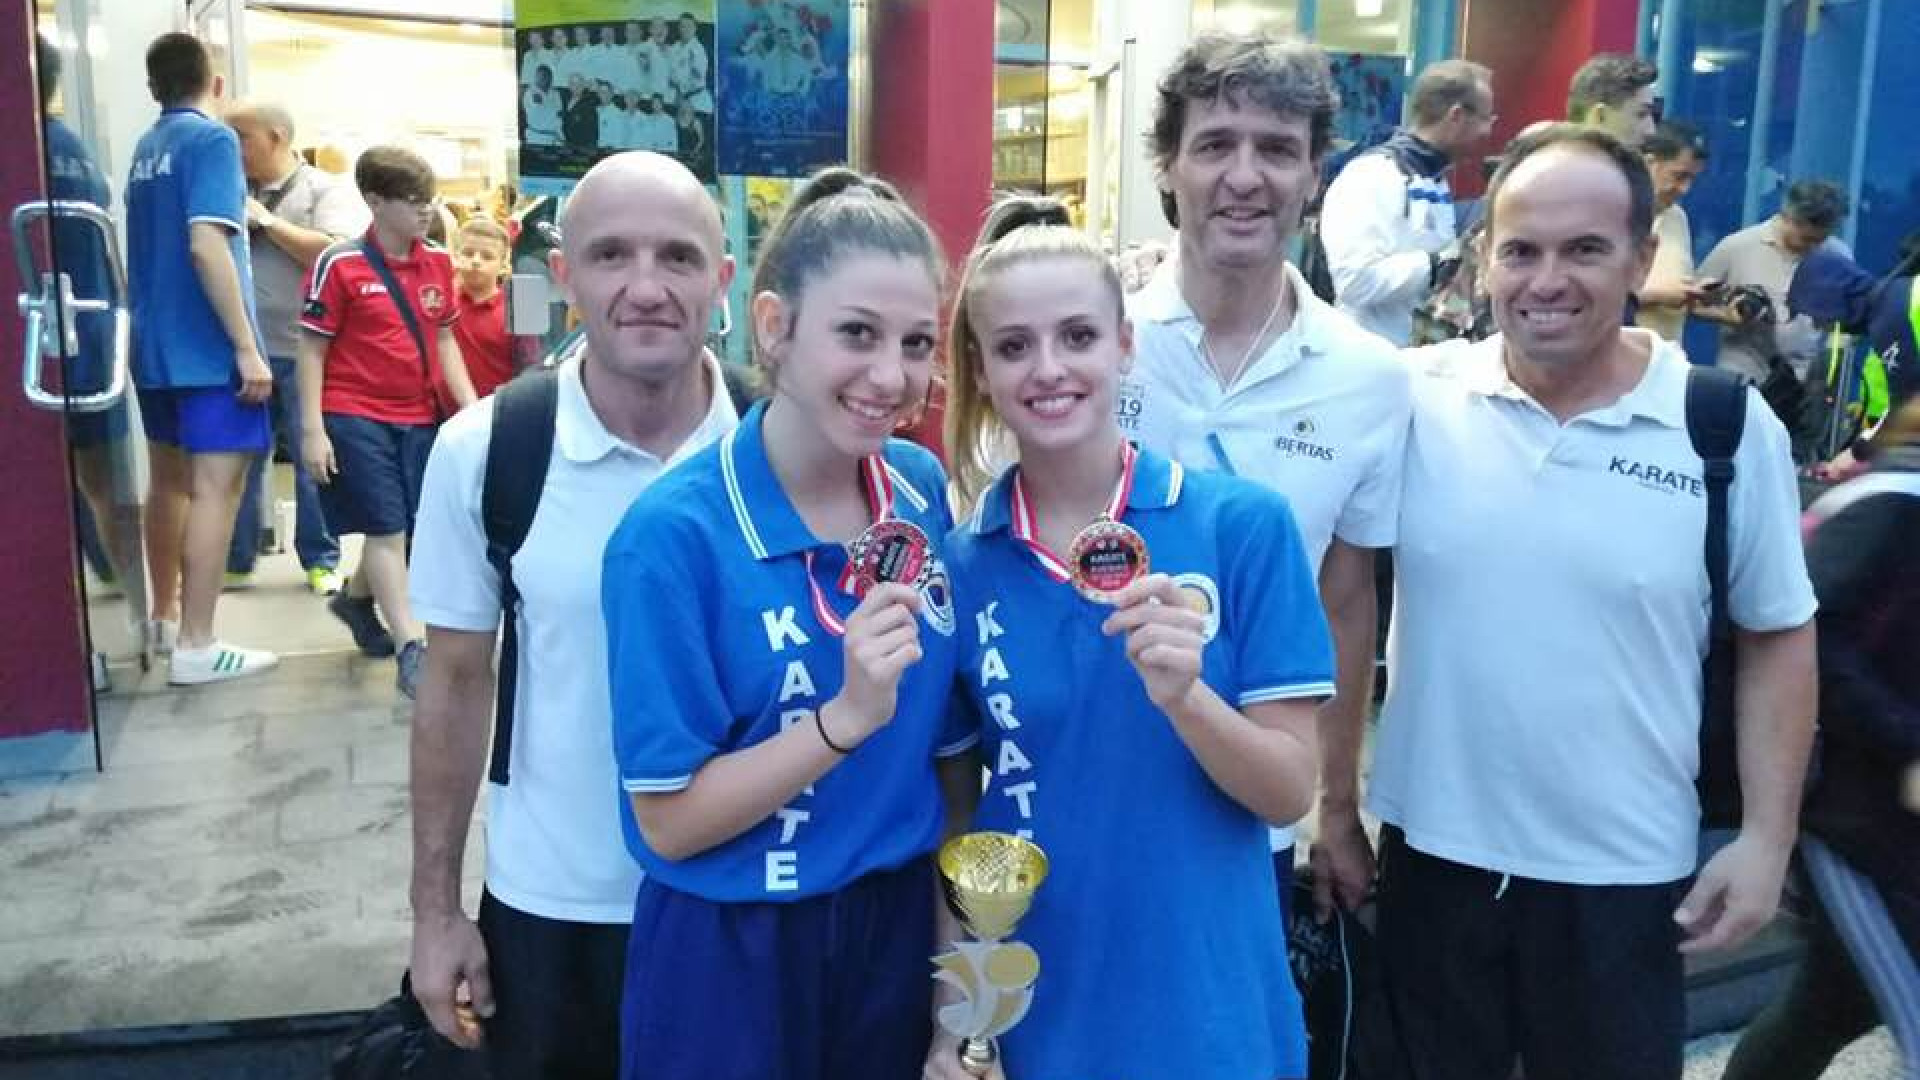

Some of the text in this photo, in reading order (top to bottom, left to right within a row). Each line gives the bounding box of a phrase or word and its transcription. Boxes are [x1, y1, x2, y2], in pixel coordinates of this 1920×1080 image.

[1608, 455, 1703, 499] KARATE
[761, 605, 817, 893] KATE
[975, 600, 1038, 840] KARAT
